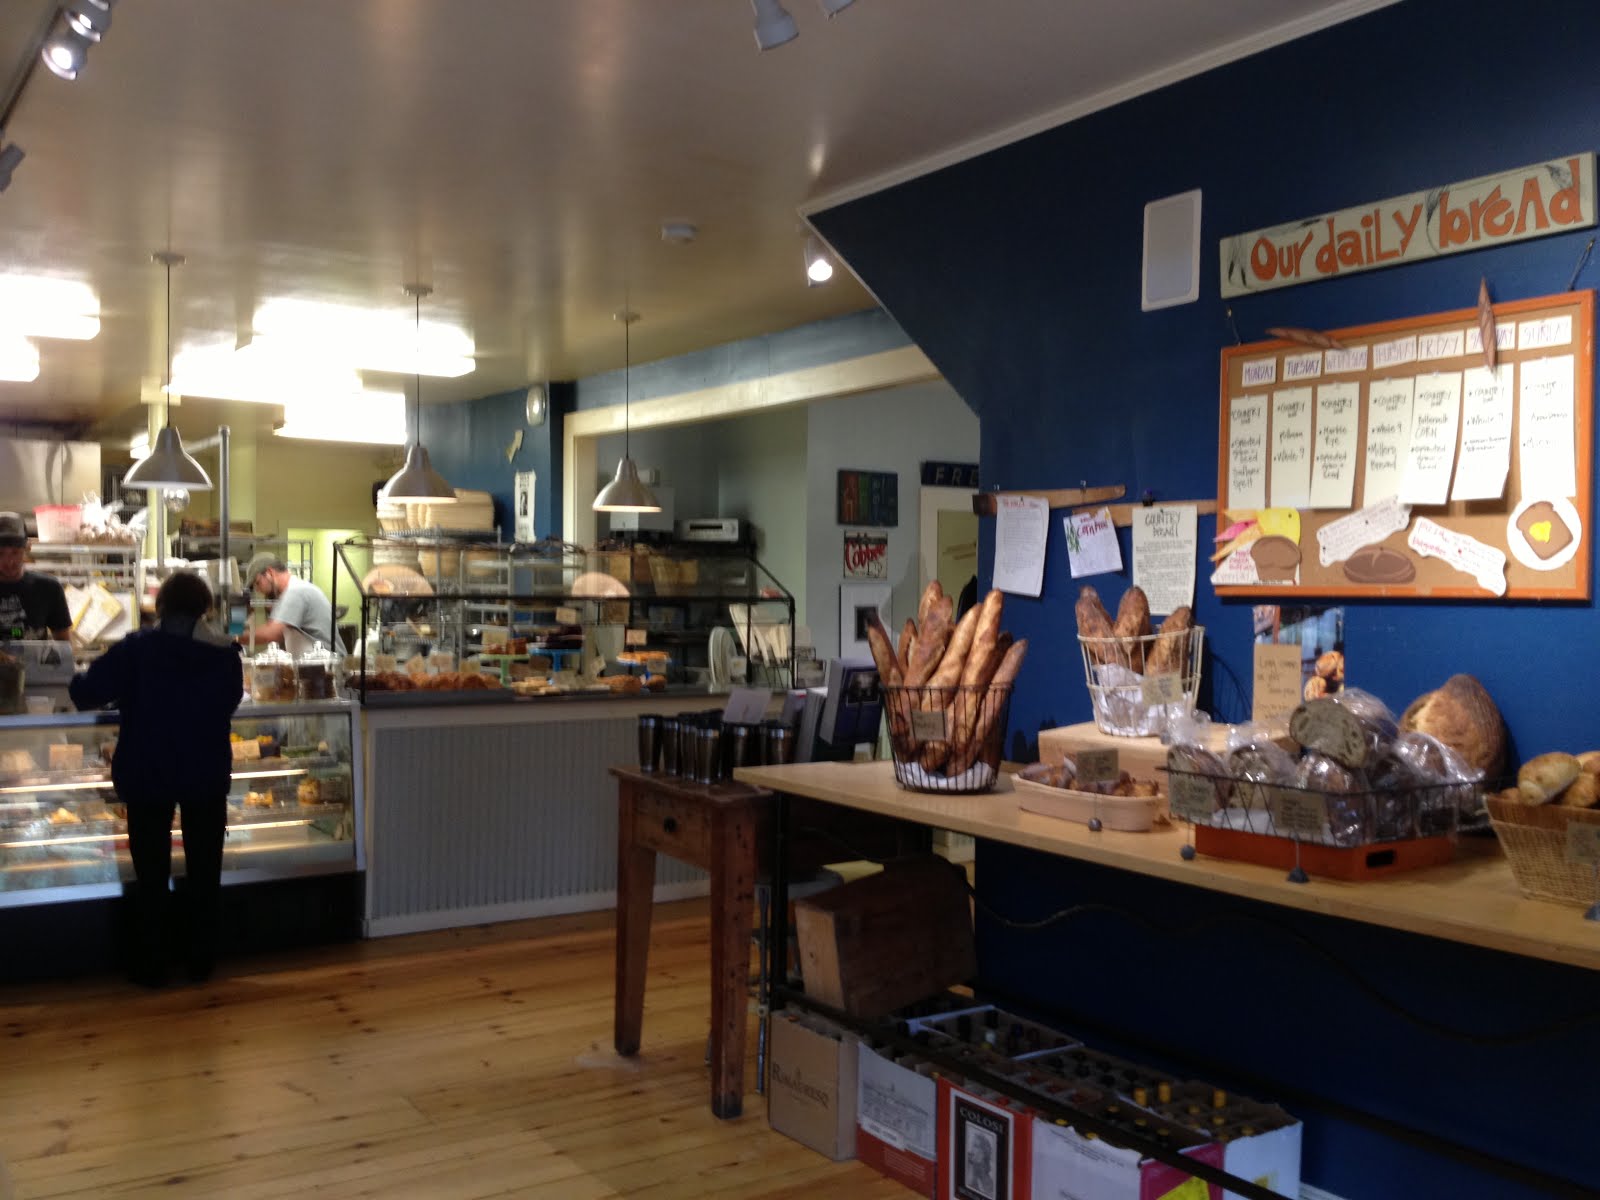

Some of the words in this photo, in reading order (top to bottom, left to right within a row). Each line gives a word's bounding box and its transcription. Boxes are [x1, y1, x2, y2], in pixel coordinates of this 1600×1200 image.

[1251, 230, 1313, 280] Our
[1244, 366, 1274, 382] MONDAY
[1286, 359, 1319, 377] TUESDAY
[1145, 511, 1181, 527] COUNTRY
[959, 1106, 1004, 1135] COLOSI
